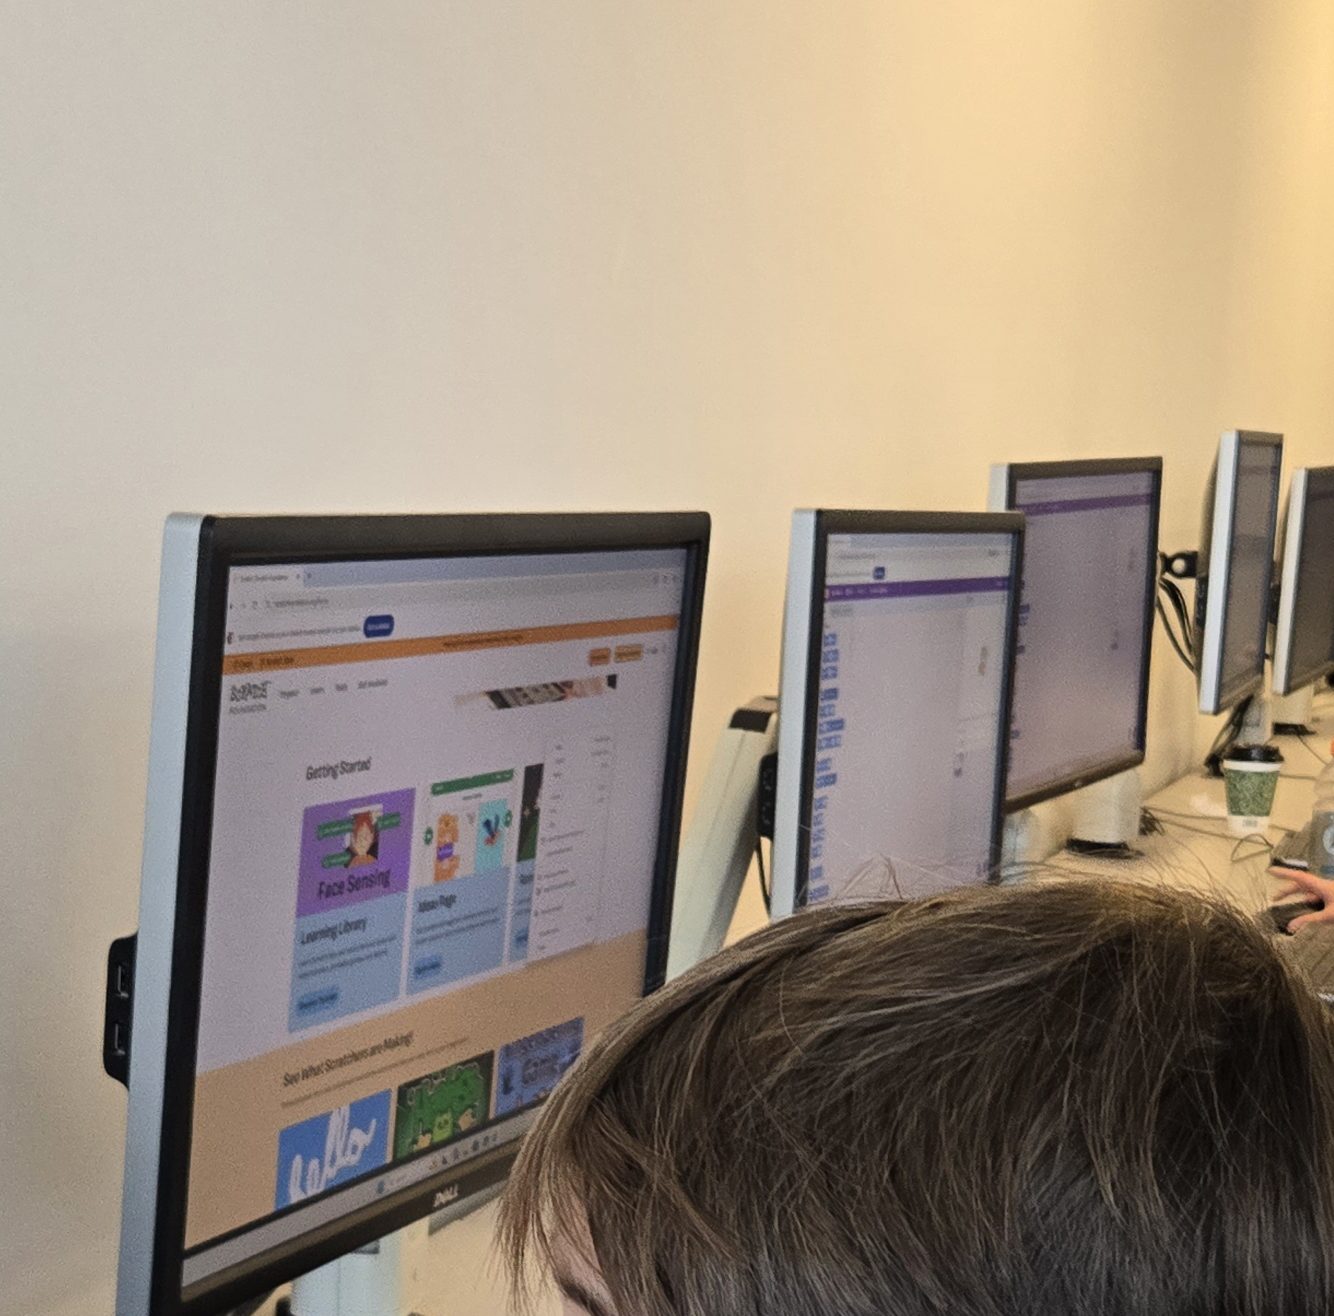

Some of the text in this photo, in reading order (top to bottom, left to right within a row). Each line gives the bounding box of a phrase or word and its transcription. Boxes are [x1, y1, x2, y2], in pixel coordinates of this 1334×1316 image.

[305, 757, 373, 781] Getting Started
[347, 868, 391, 894] Sensing
